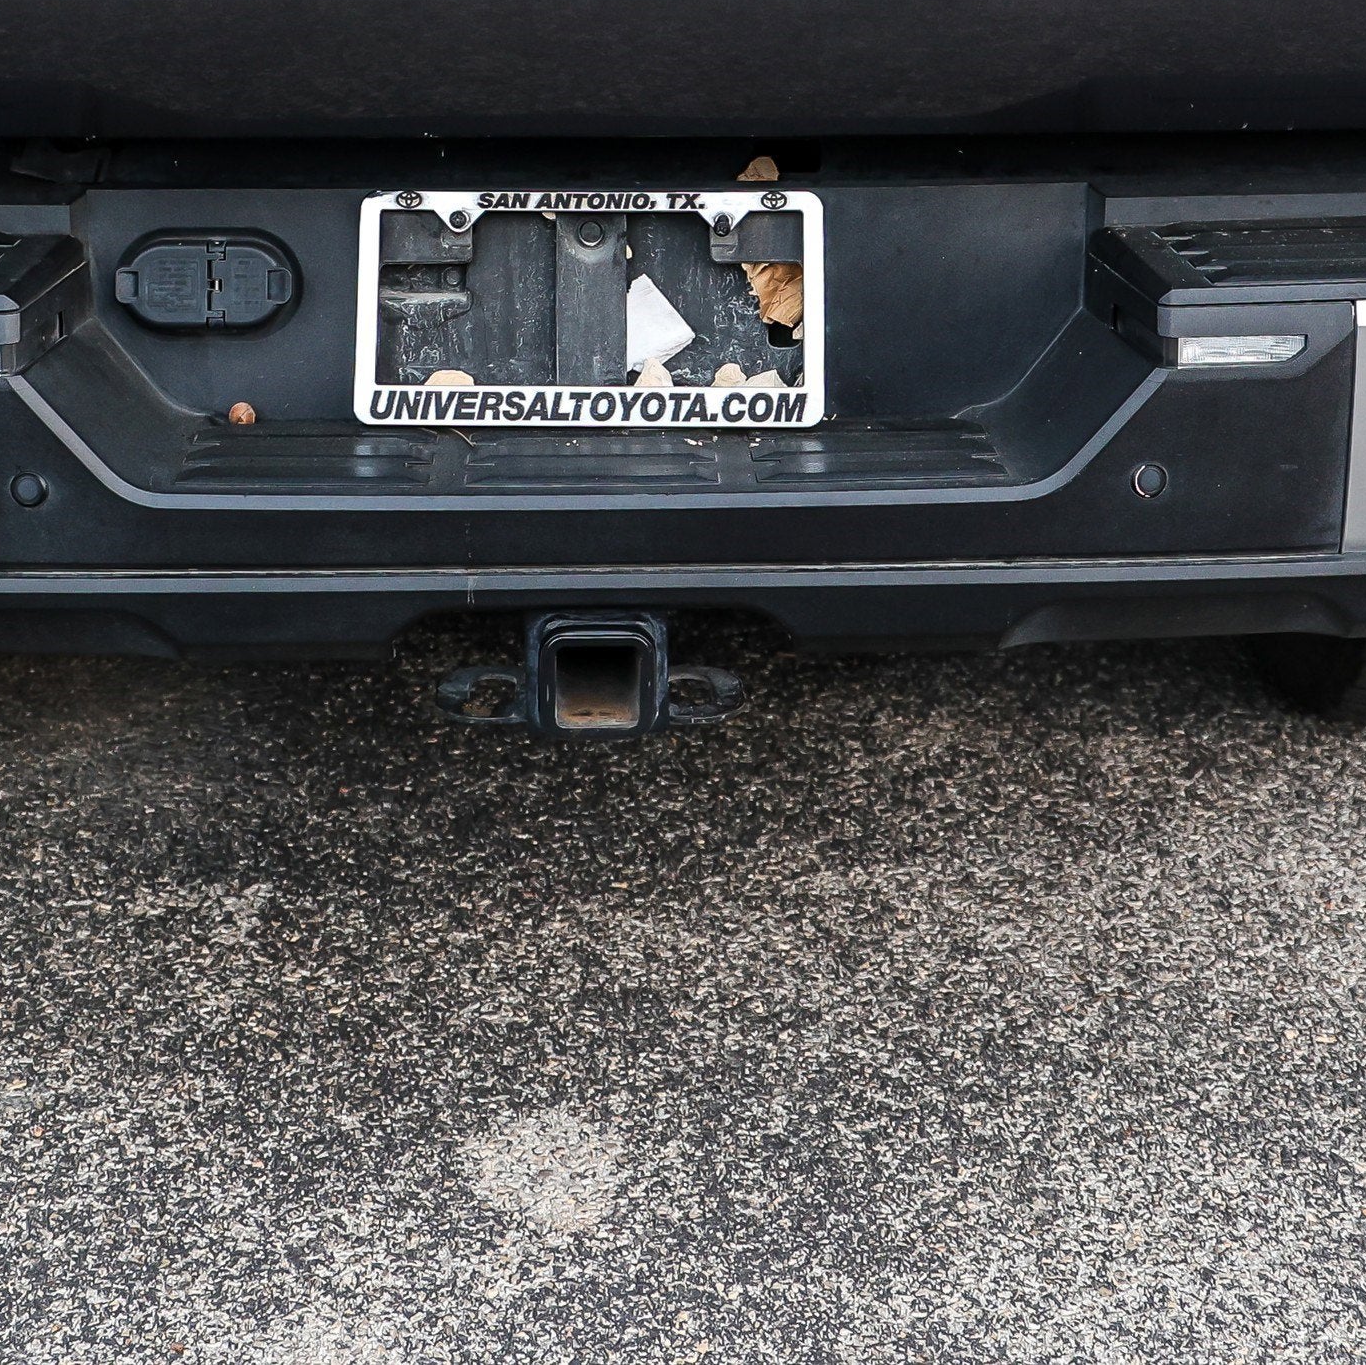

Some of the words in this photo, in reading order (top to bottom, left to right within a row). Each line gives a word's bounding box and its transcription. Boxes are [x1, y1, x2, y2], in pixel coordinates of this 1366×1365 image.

[477, 192, 529, 209] SAN
[535, 192, 657, 211] ANTONIO,
[666, 193, 706, 210] TX.
[369, 390, 807, 423] UNIVERSALTOYOTA.COM
